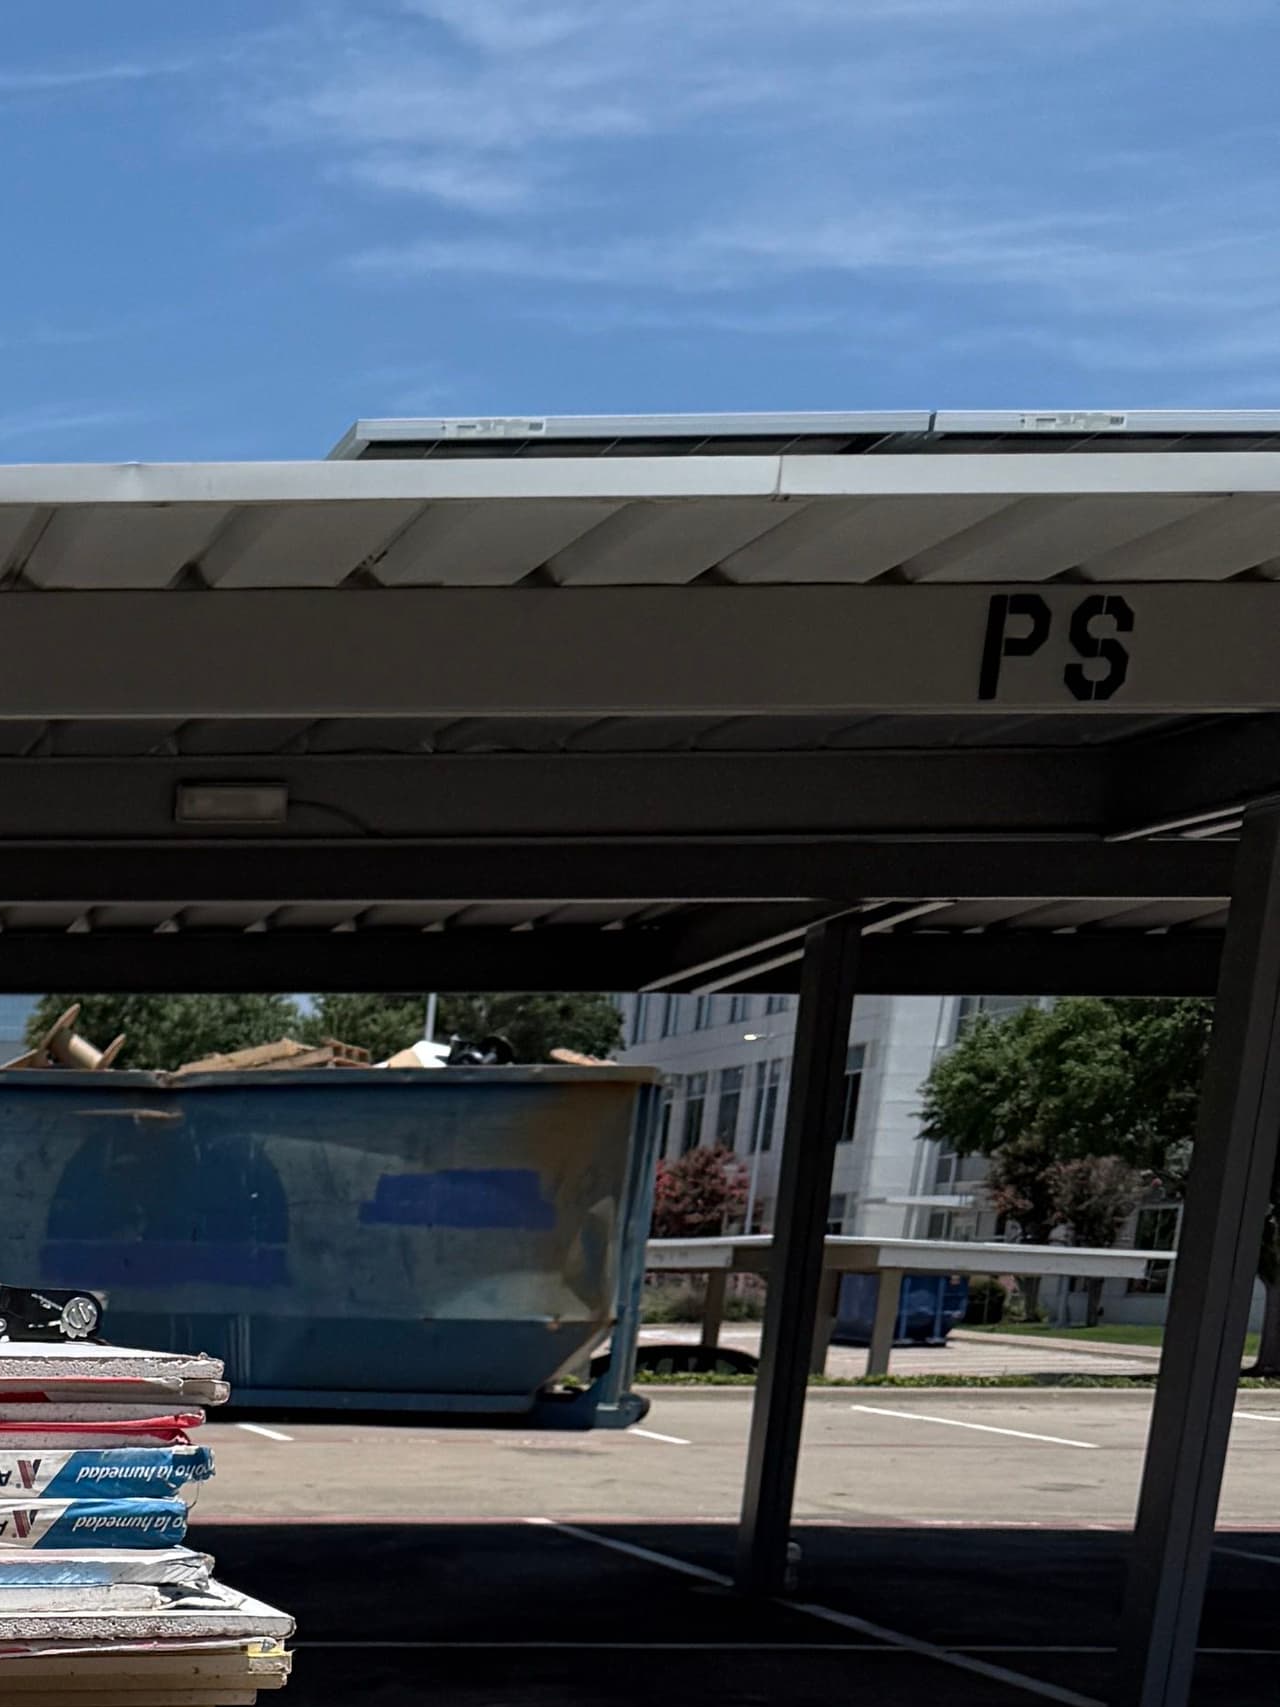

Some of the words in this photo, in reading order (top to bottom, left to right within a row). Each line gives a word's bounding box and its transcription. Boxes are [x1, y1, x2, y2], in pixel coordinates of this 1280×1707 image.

[978, 594, 1135, 700] PS
[76, 1466, 153, 1482] humedad
[156, 1465, 173, 1480] la
[72, 1516, 154, 1532] humedad
[153, 1516, 171, 1532] la
